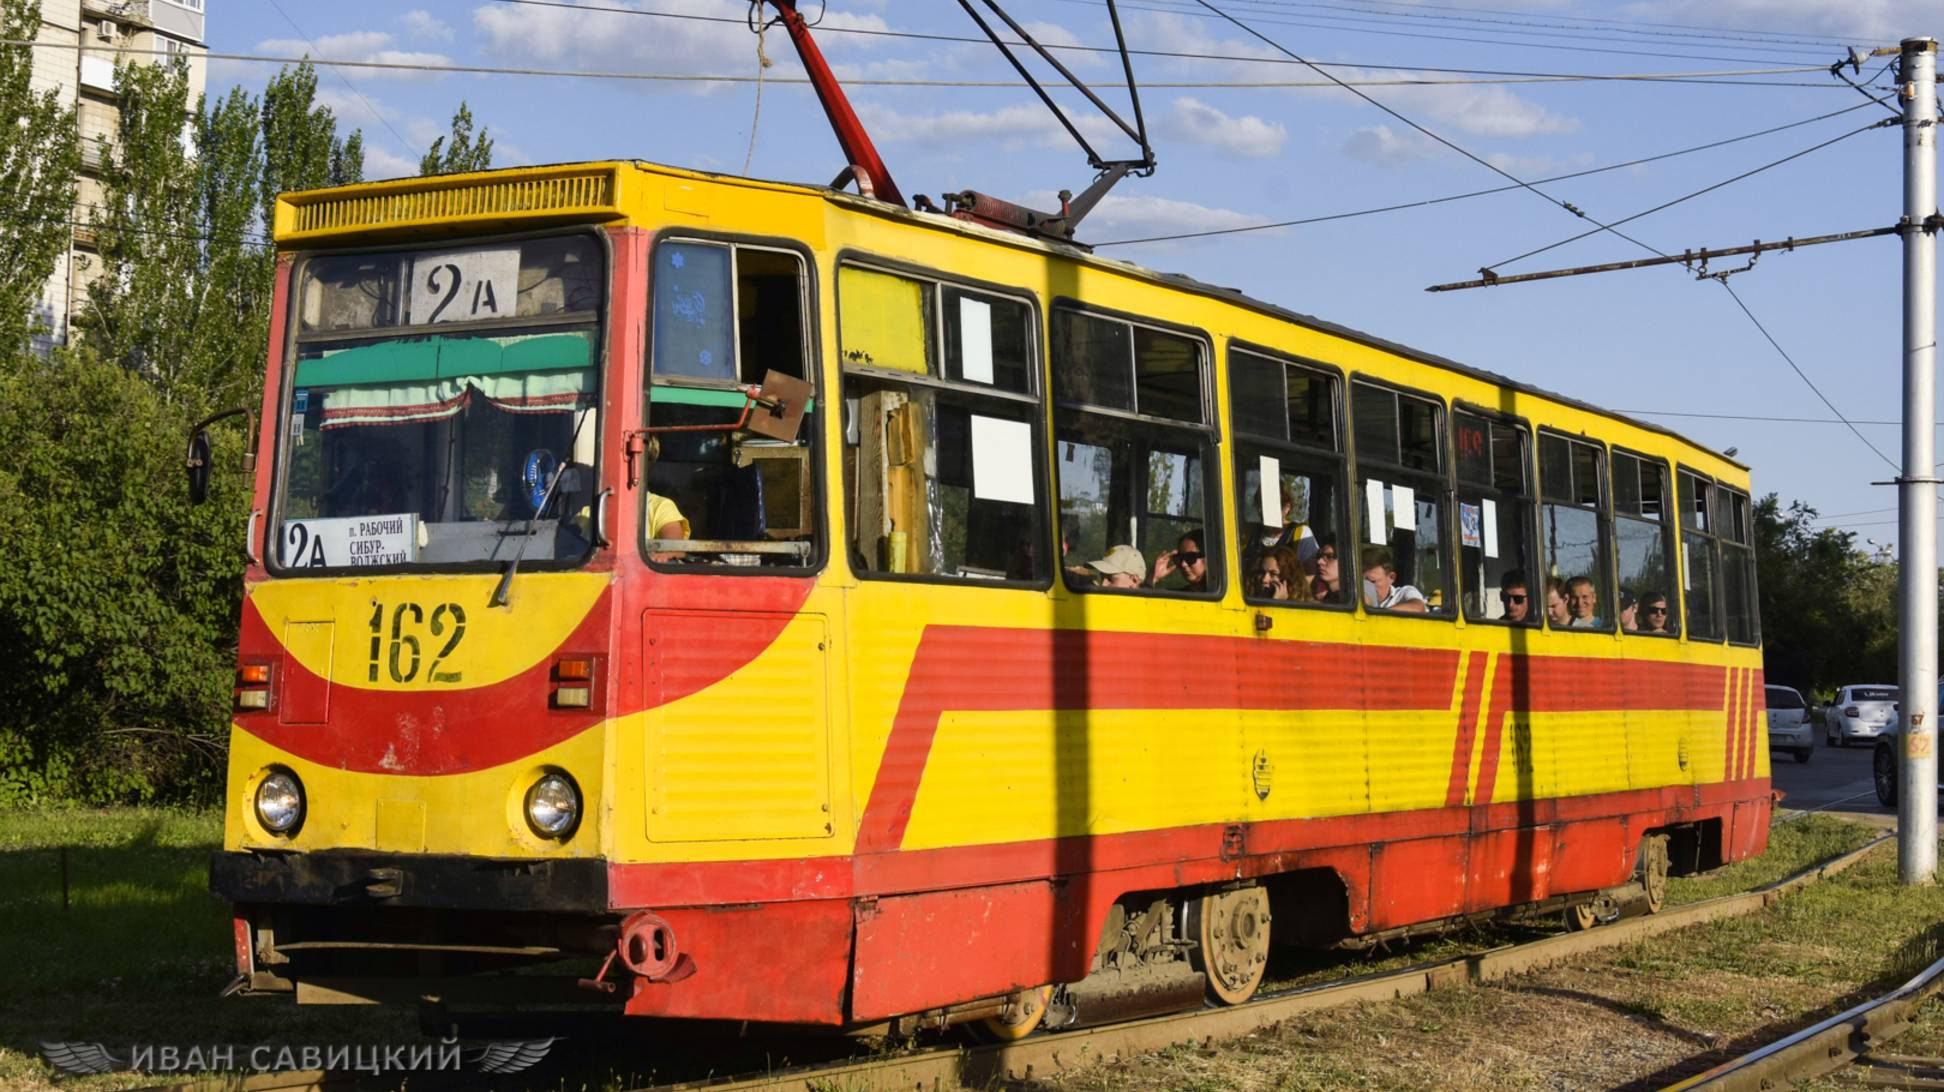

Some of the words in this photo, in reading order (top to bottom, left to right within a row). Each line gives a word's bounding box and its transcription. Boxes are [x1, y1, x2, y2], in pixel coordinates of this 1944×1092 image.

[360, 517, 403, 536] РАБОЧИЙ
[289, 522, 328, 568] 2А
[349, 539, 385, 555] СИБУР-
[368, 602, 466, 683] 162
